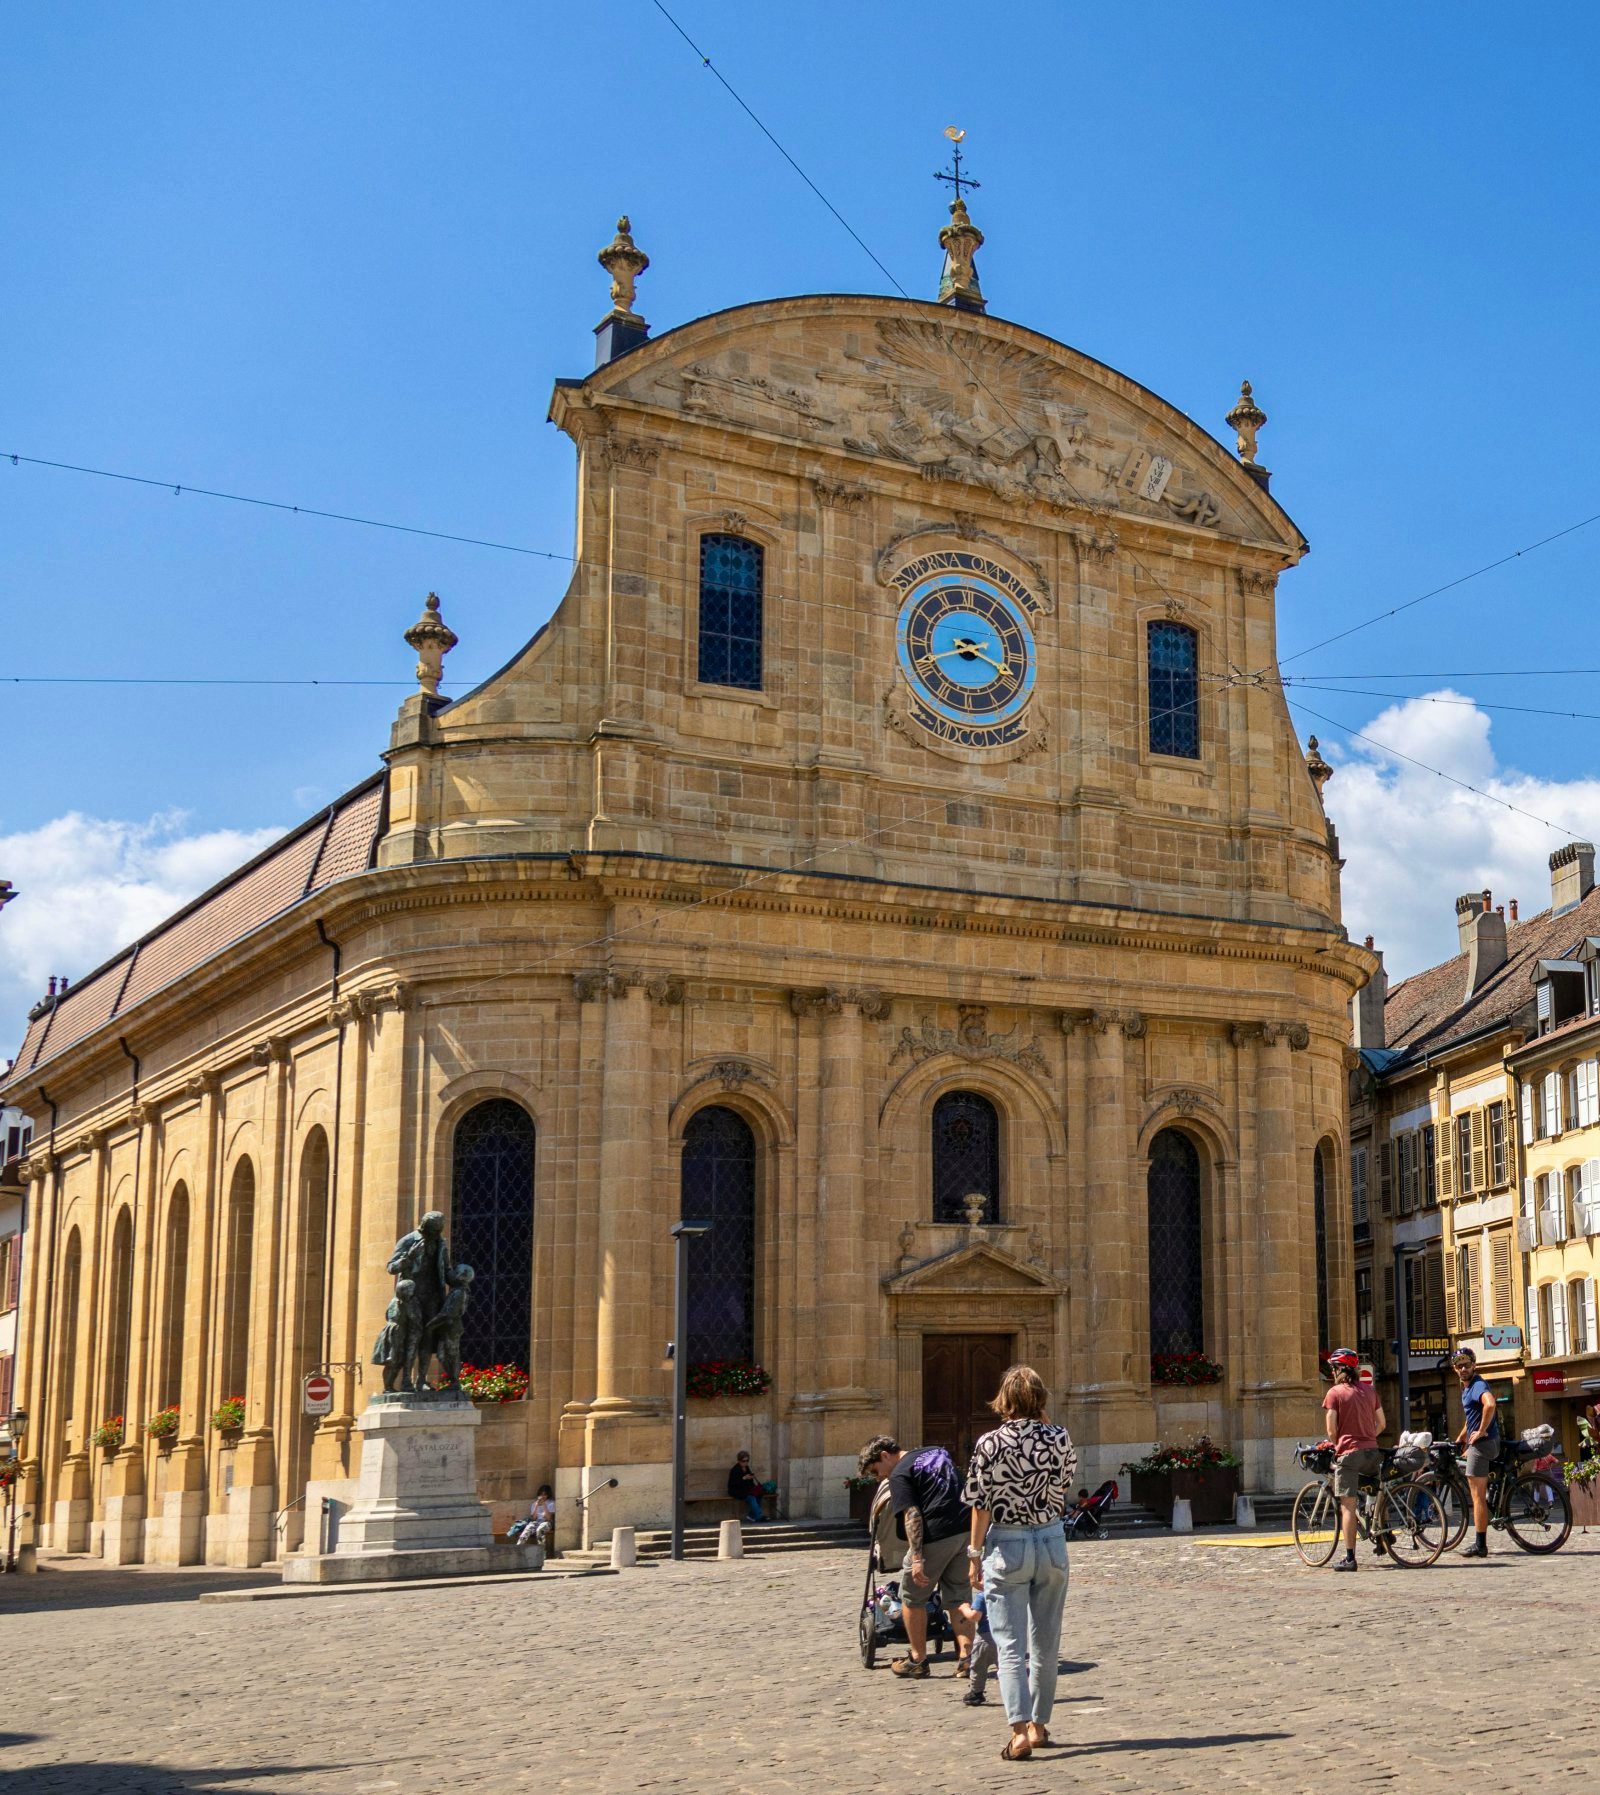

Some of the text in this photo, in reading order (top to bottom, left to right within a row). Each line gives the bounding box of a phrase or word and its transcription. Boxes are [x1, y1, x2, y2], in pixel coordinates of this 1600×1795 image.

[1506, 1336, 1520, 1344] TUI
[1535, 1377, 1563, 1386] amplifon
[408, 1443, 458, 1452] PESTALOZZI
